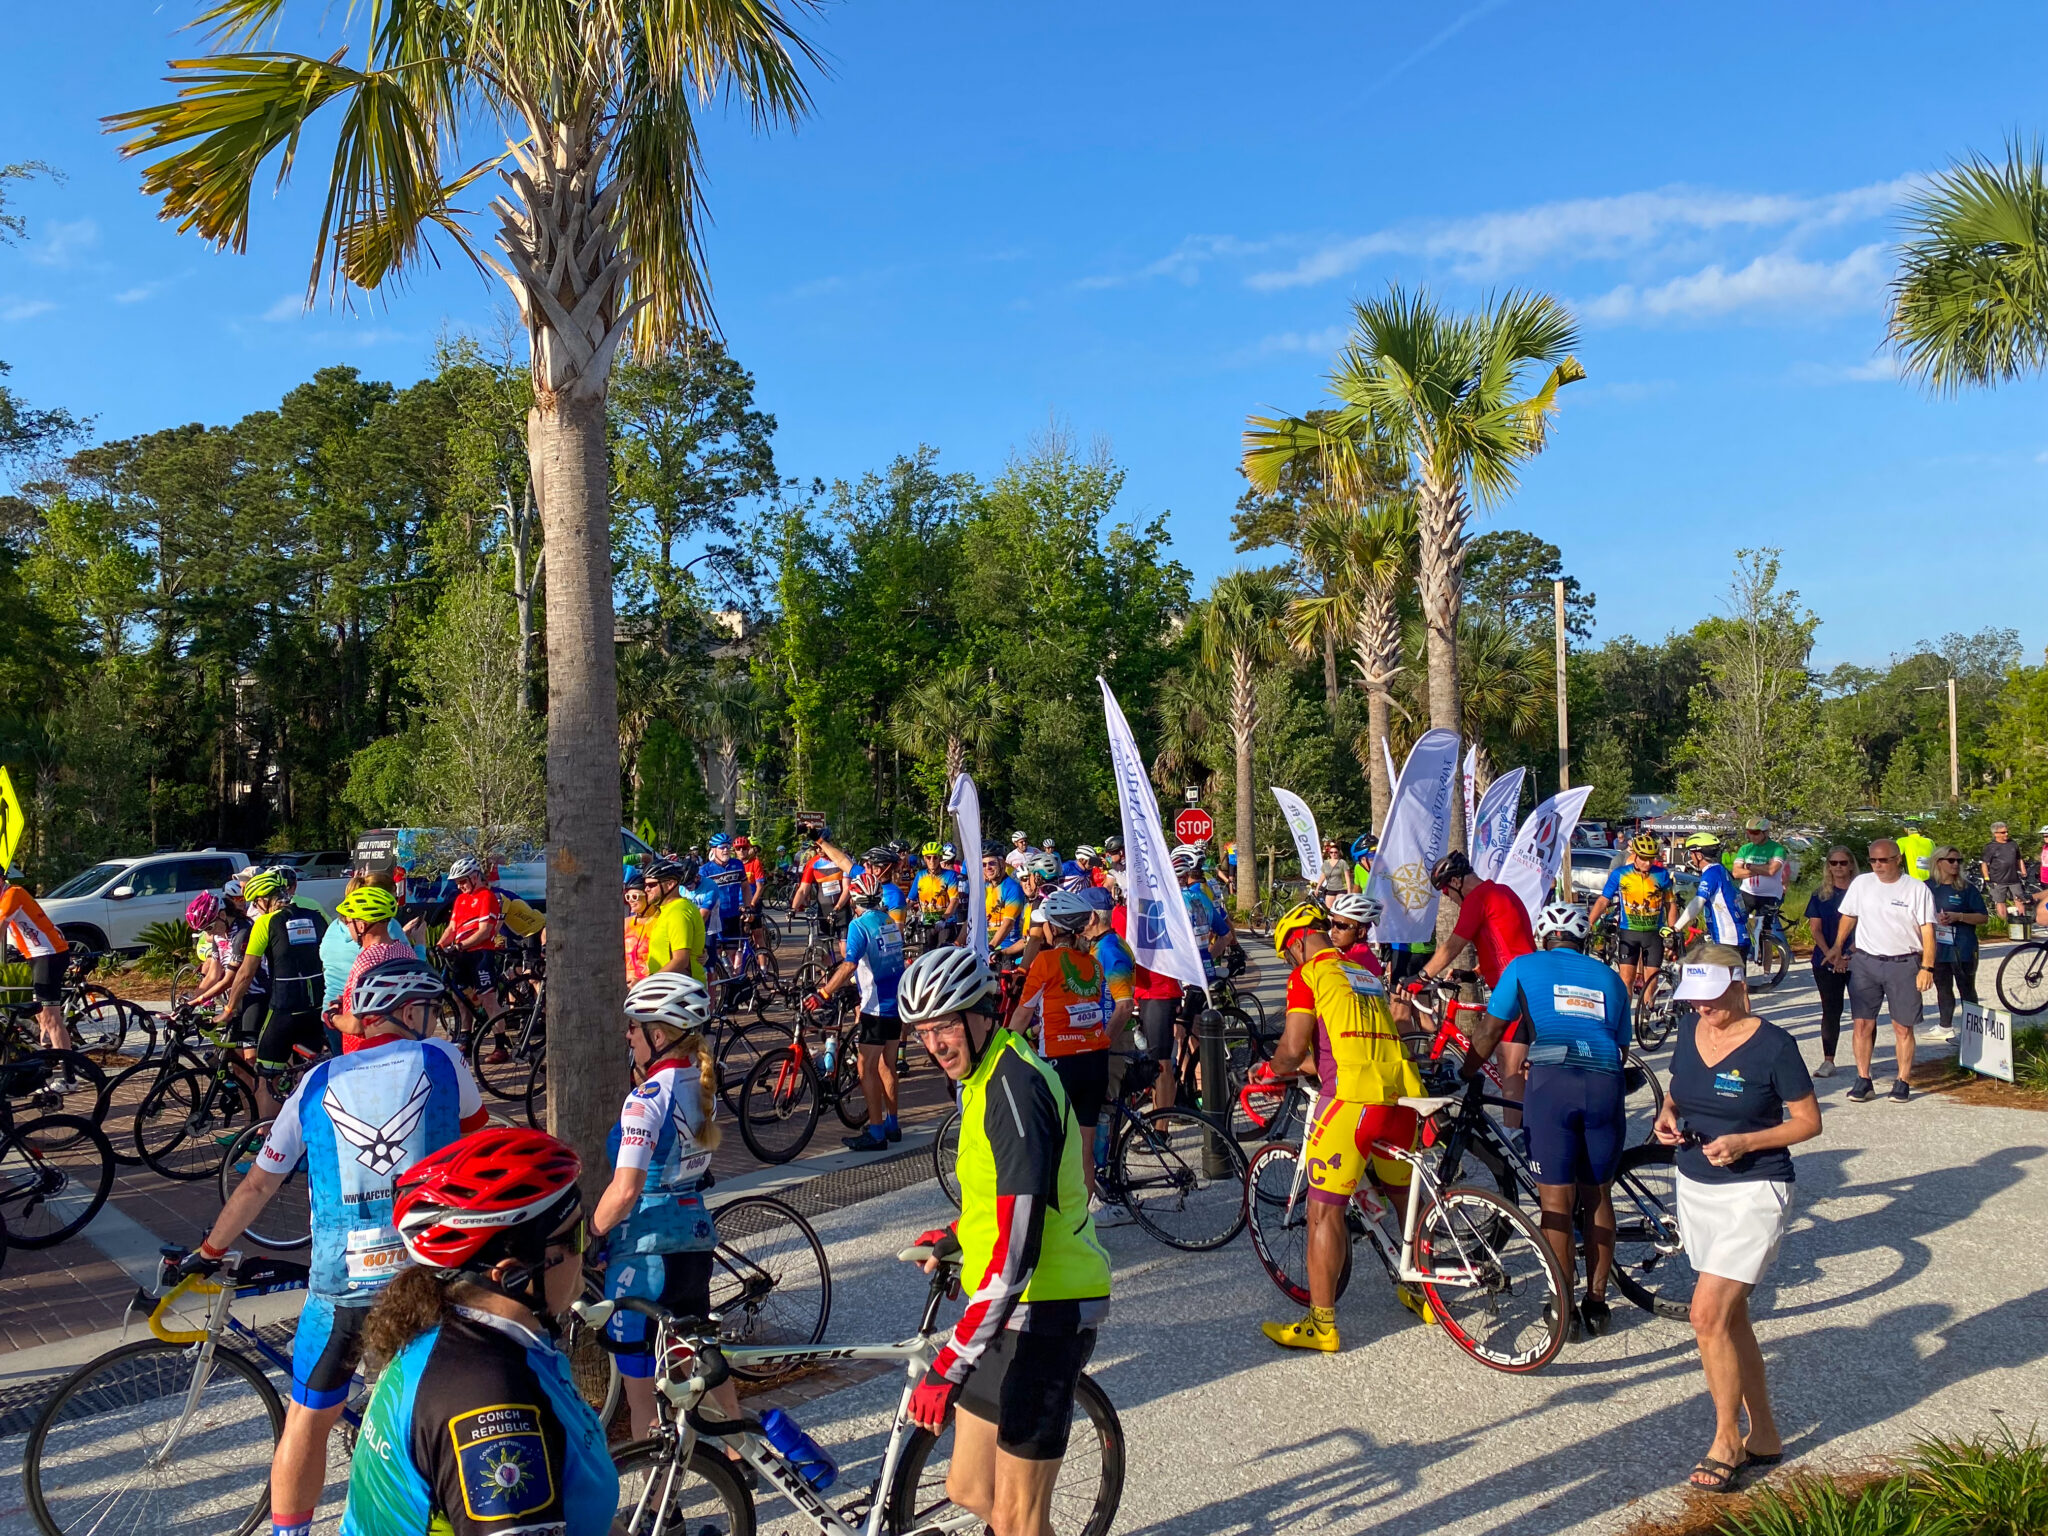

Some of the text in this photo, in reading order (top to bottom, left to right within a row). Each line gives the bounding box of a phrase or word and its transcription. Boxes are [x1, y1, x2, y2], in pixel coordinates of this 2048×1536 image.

[1178, 820, 1210, 836] STOP
[357, 840, 391, 850] GREAT FUTURES
[358, 851, 386, 860] START HERE.
[1686, 967, 1707, 976] PEDAL
[1566, 998, 1595, 1009] 6520
[1966, 1012, 1989, 1036] FIRST
[626, 1126, 652, 1138] Years
[621, 1136, 644, 1146] 2022
[264, 1145, 287, 1163] 1947
[459, 1216, 506, 1225] GARNEAU
[363, 1248, 409, 1267] 6070
[757, 1349, 858, 1365] TREK
[477, 1410, 521, 1425] CONCH
[471, 1421, 530, 1440] REPUBLIC
[479, 1442, 498, 1461] CONCH
[758, 1451, 839, 1531] TREK
